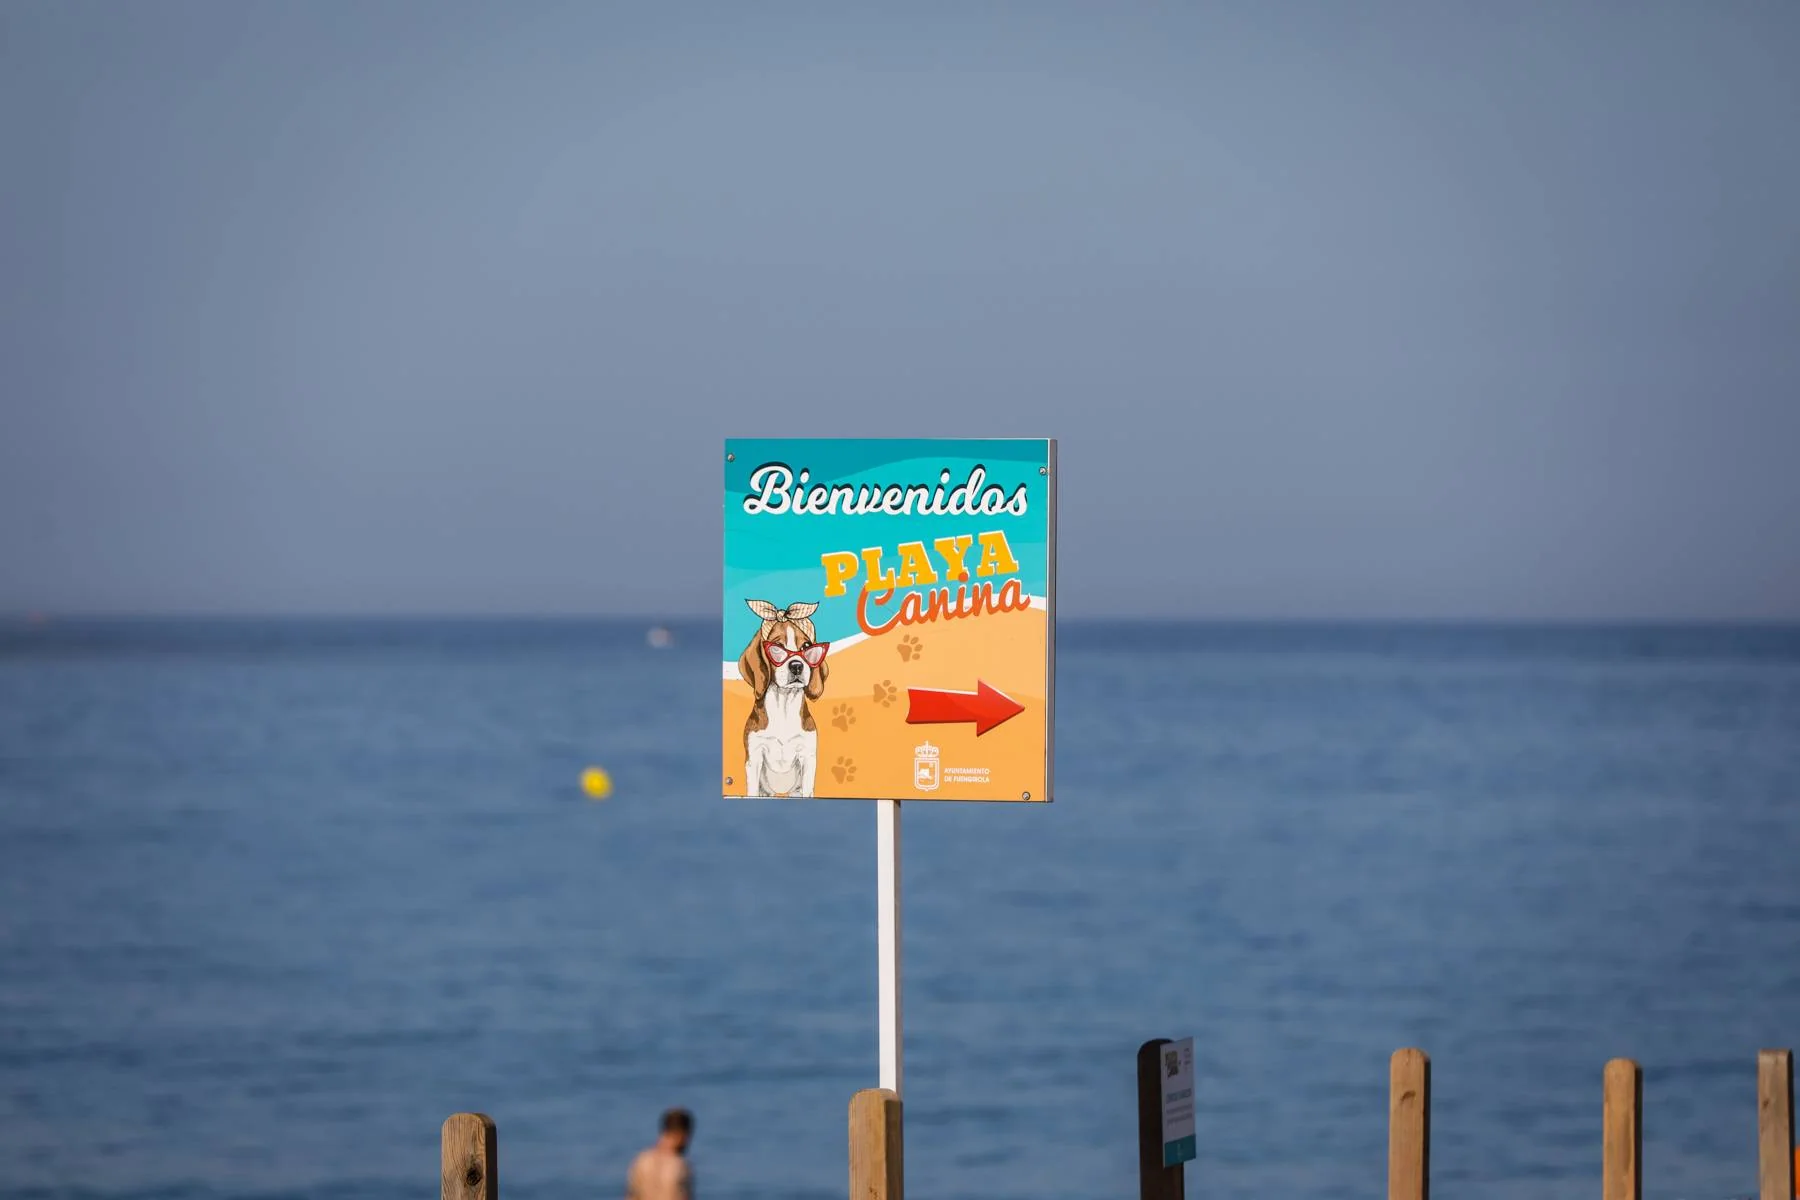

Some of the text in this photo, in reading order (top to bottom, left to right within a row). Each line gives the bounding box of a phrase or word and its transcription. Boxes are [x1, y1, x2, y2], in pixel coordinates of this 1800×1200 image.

[743, 461, 1028, 516] Bienvenidos
[821, 530, 1019, 597] PLAYA
[856, 572, 1031, 636] Canina
